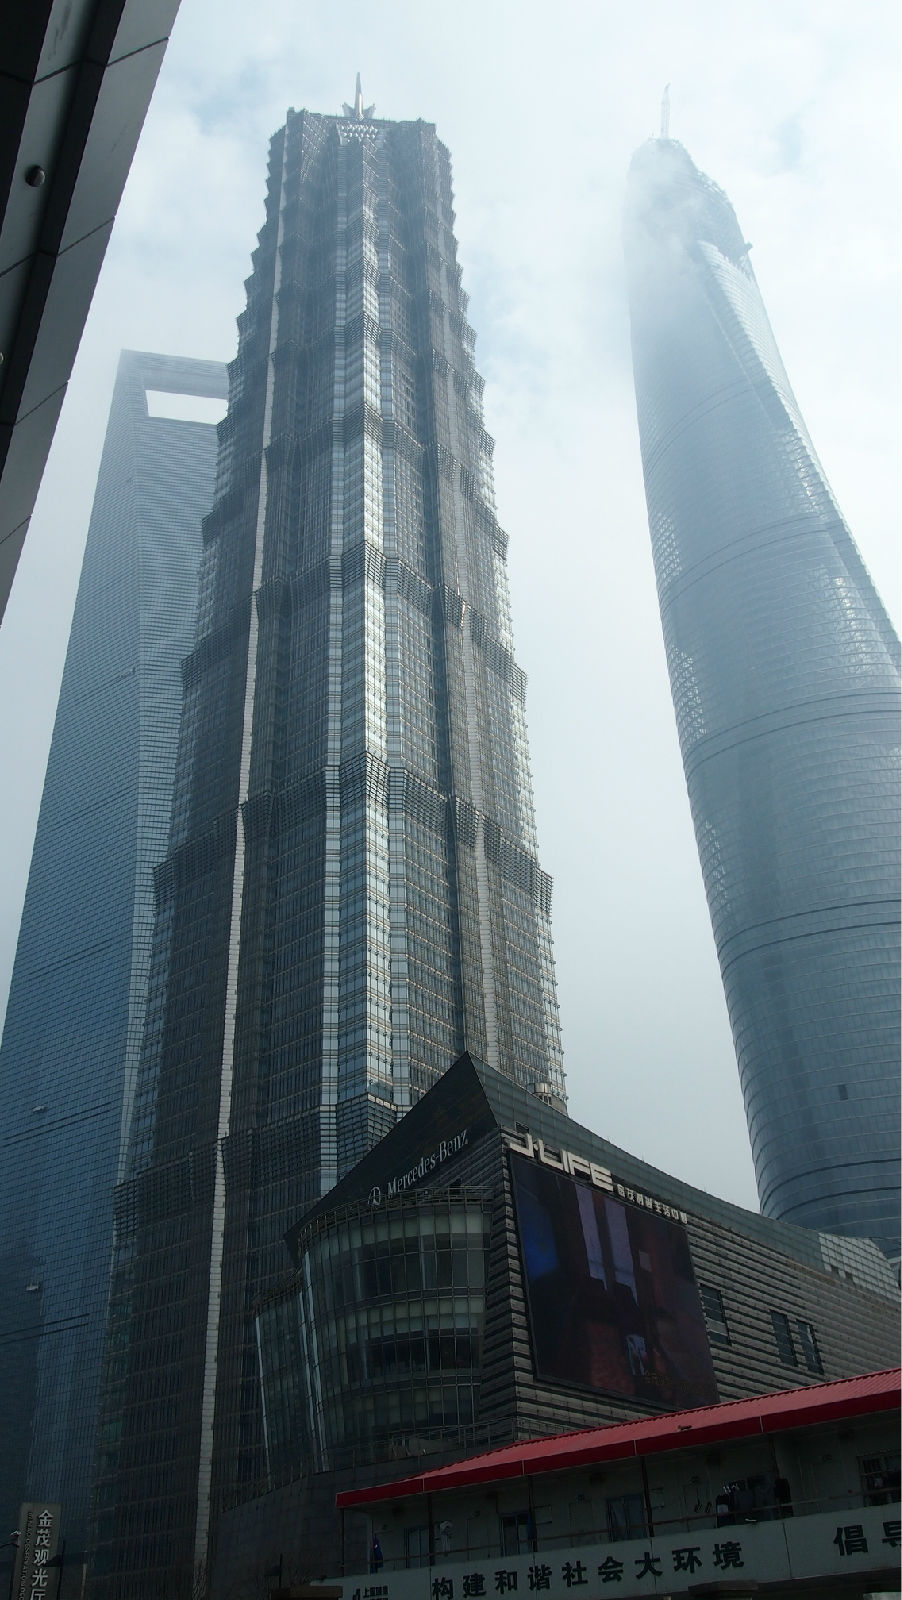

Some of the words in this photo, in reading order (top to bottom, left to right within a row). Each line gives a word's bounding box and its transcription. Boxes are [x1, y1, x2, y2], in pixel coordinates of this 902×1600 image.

[386, 1128, 469, 1199] Mercedes-Benz
[431, 1540, 745, 1600] 构建和谐社会大环境
